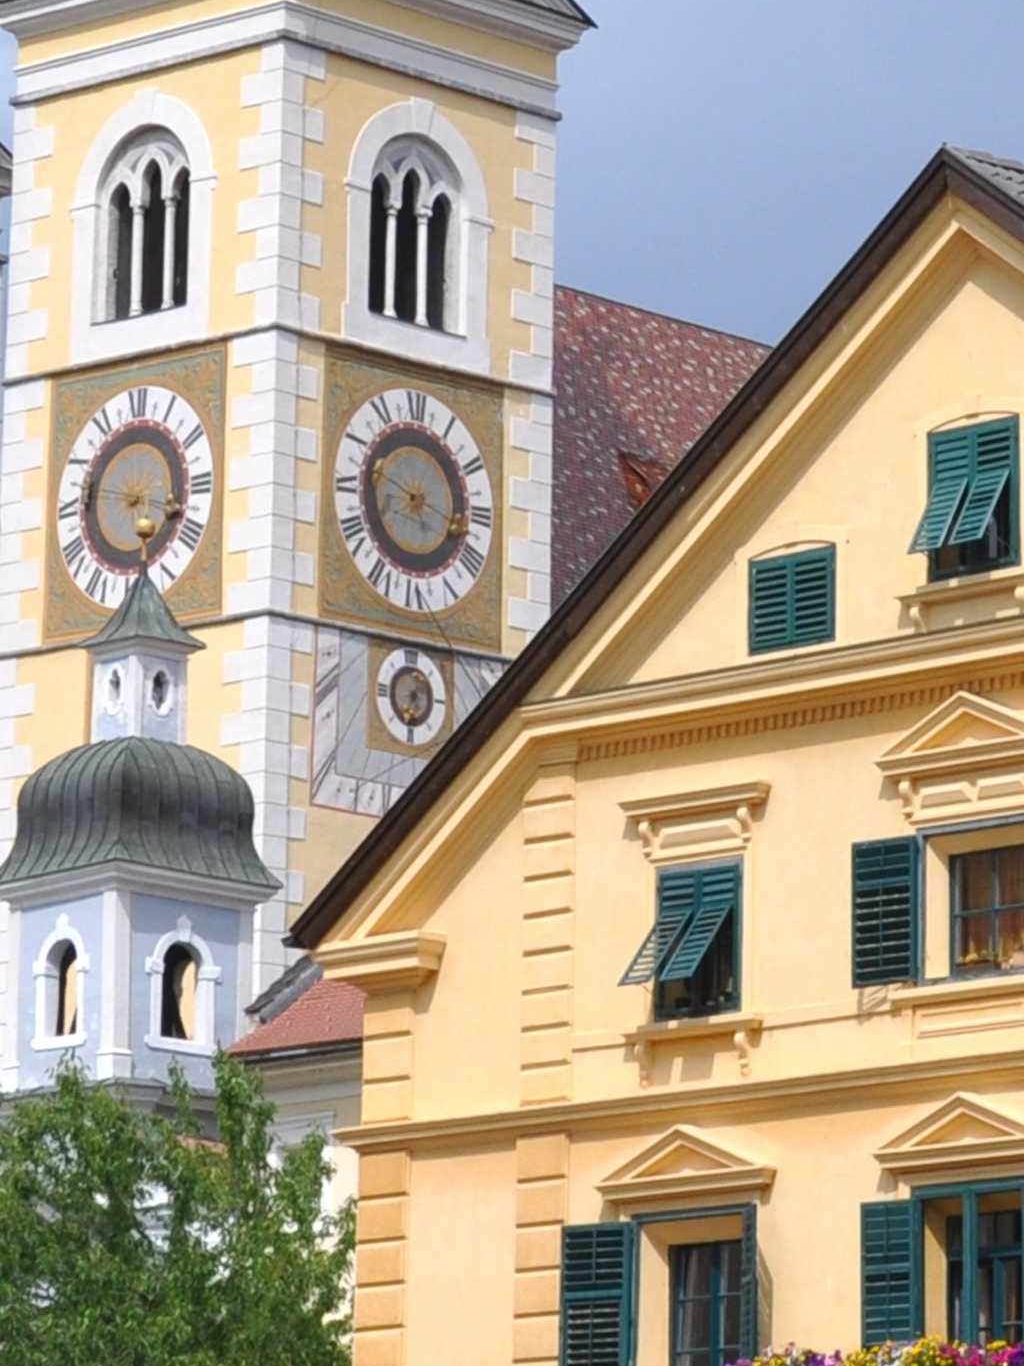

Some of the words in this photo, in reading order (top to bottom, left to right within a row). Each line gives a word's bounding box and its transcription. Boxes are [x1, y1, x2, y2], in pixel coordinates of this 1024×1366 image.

[163, 394, 176, 423] I
[183, 423, 204, 449] II
[443, 416, 456, 439] I
[463, 457, 484, 476] II
[190, 471, 212, 494] III
[471, 506, 491, 528] III
